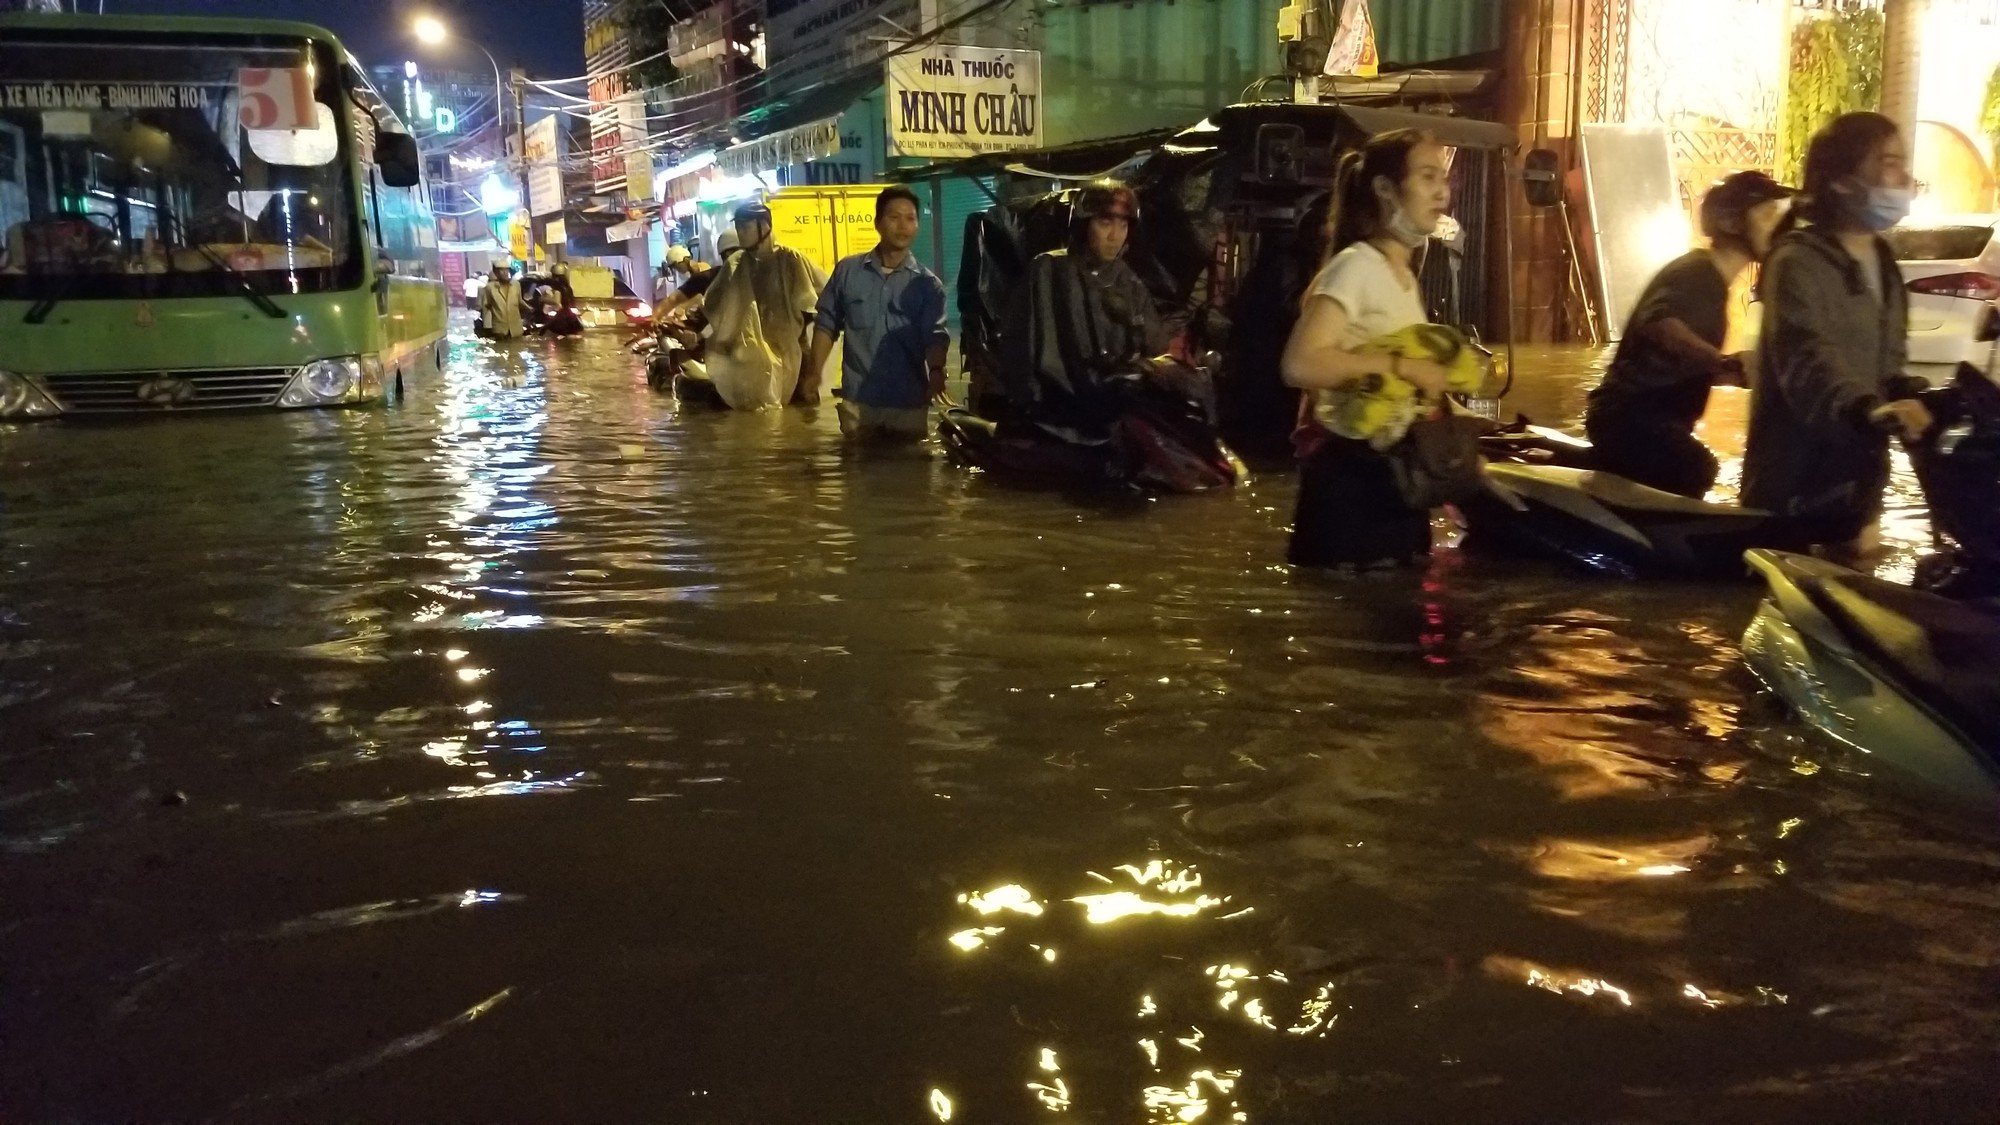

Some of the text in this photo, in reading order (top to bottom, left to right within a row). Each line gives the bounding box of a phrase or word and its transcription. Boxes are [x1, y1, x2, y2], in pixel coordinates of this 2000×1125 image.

[922, 54, 1015, 79] NHÀ THUỐC
[6, 85, 25, 107] XE
[239, 69, 319, 129] 51
[899, 83, 1036, 136] MINH CHÂU
[794, 215, 810, 225] XE
[848, 210, 873, 223] BÁO
